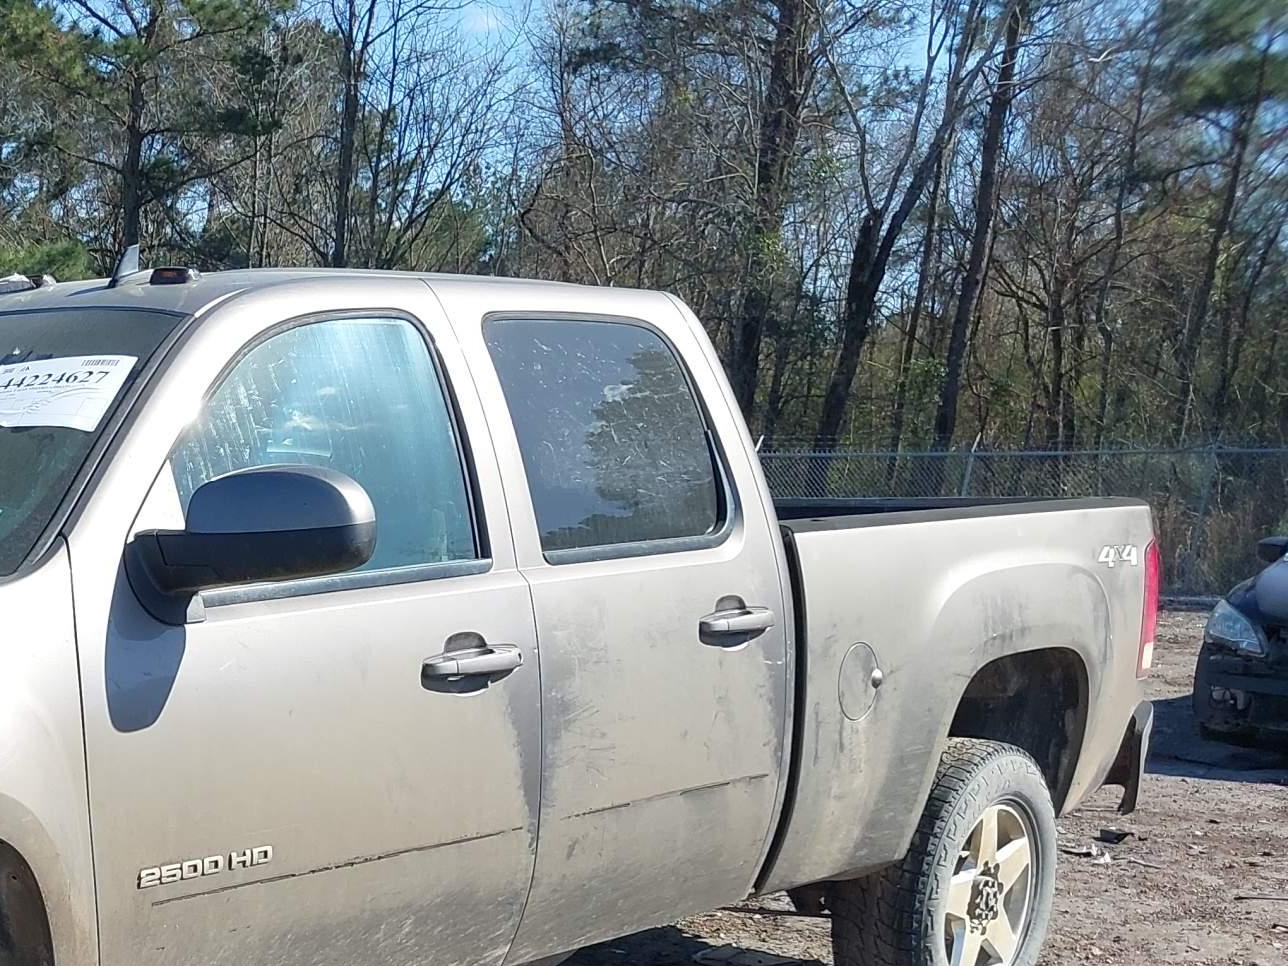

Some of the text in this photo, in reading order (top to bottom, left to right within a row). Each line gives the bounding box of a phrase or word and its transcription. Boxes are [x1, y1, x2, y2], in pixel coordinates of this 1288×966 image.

[0, 370, 110, 389] 44224627
[137, 845, 273, 889] 2500 HD
